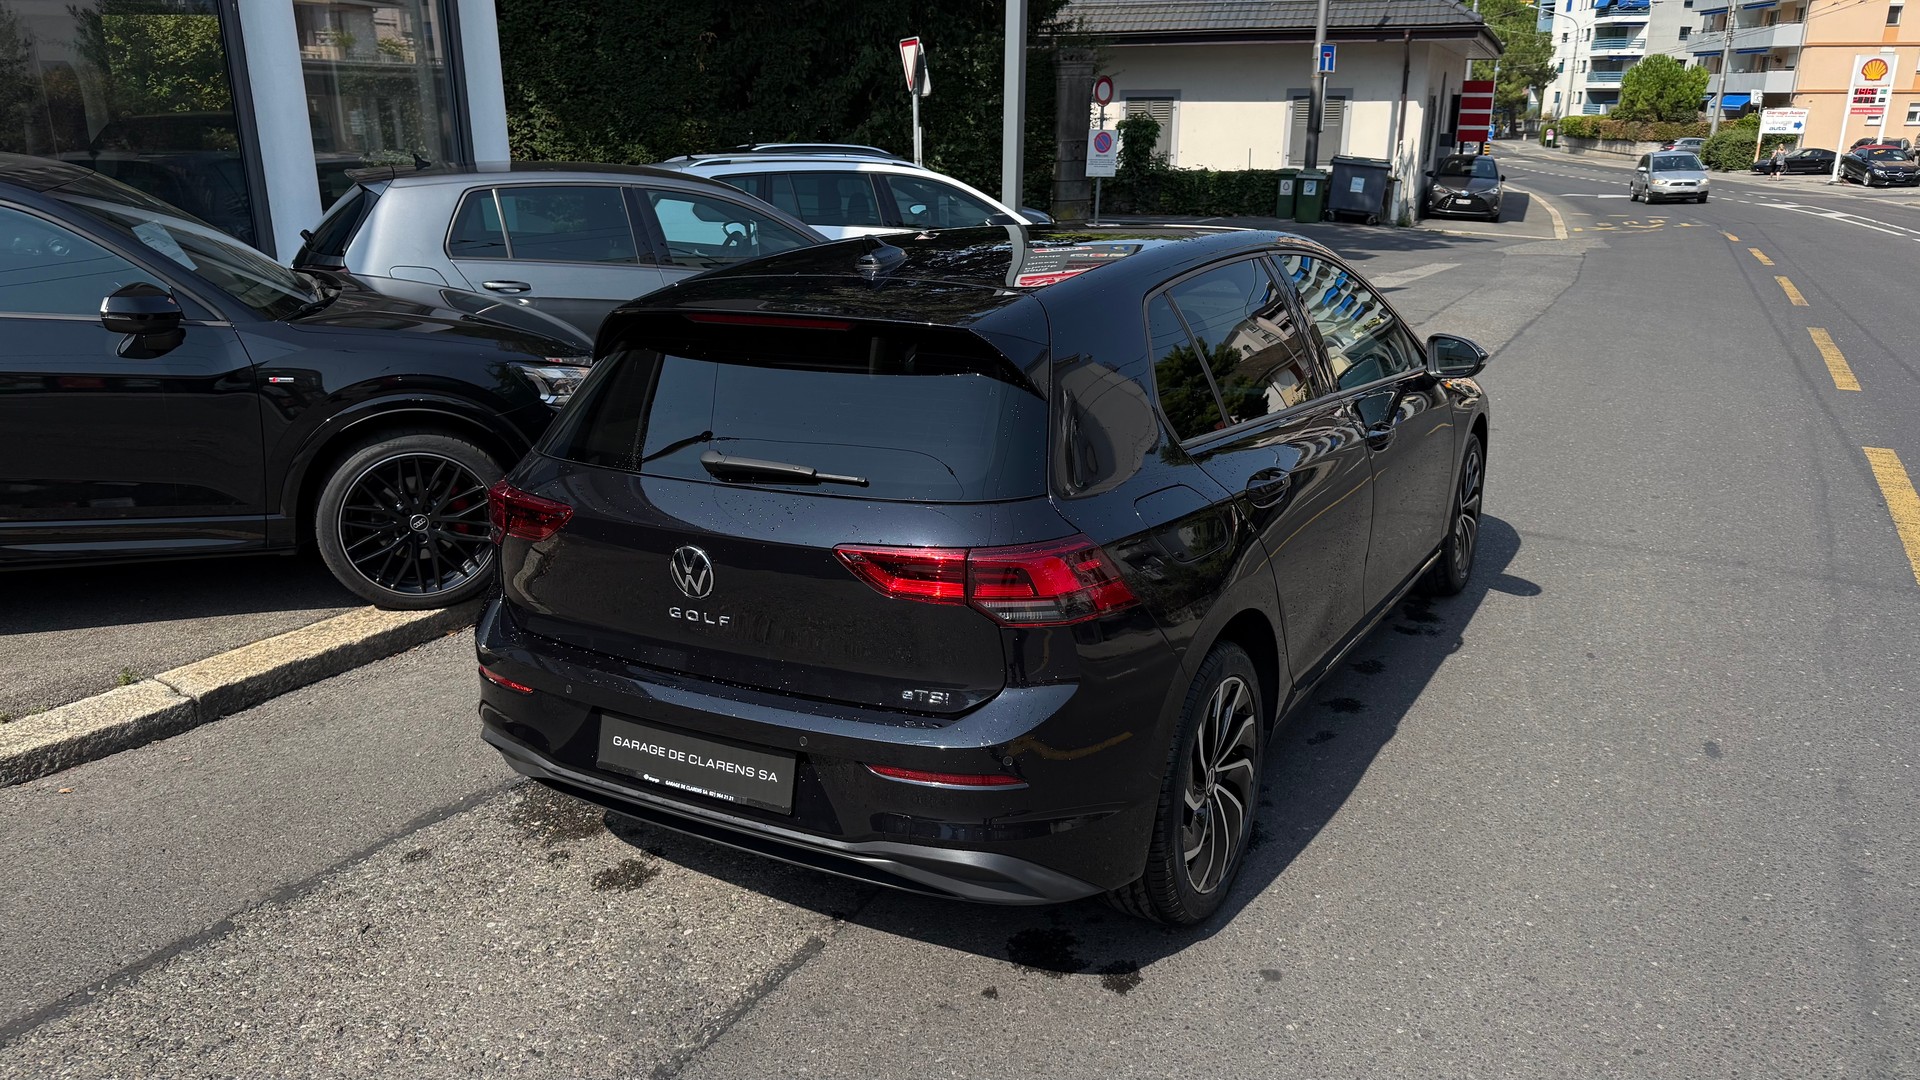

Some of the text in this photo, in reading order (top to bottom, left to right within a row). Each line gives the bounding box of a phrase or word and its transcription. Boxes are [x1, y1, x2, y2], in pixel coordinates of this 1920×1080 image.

[669, 607, 730, 626] GOLF
[613, 735, 778, 783] GARAGE DE CLARENS SA
[665, 780, 680, 788] GARAGE
[686, 785, 702, 794] CLARENS
